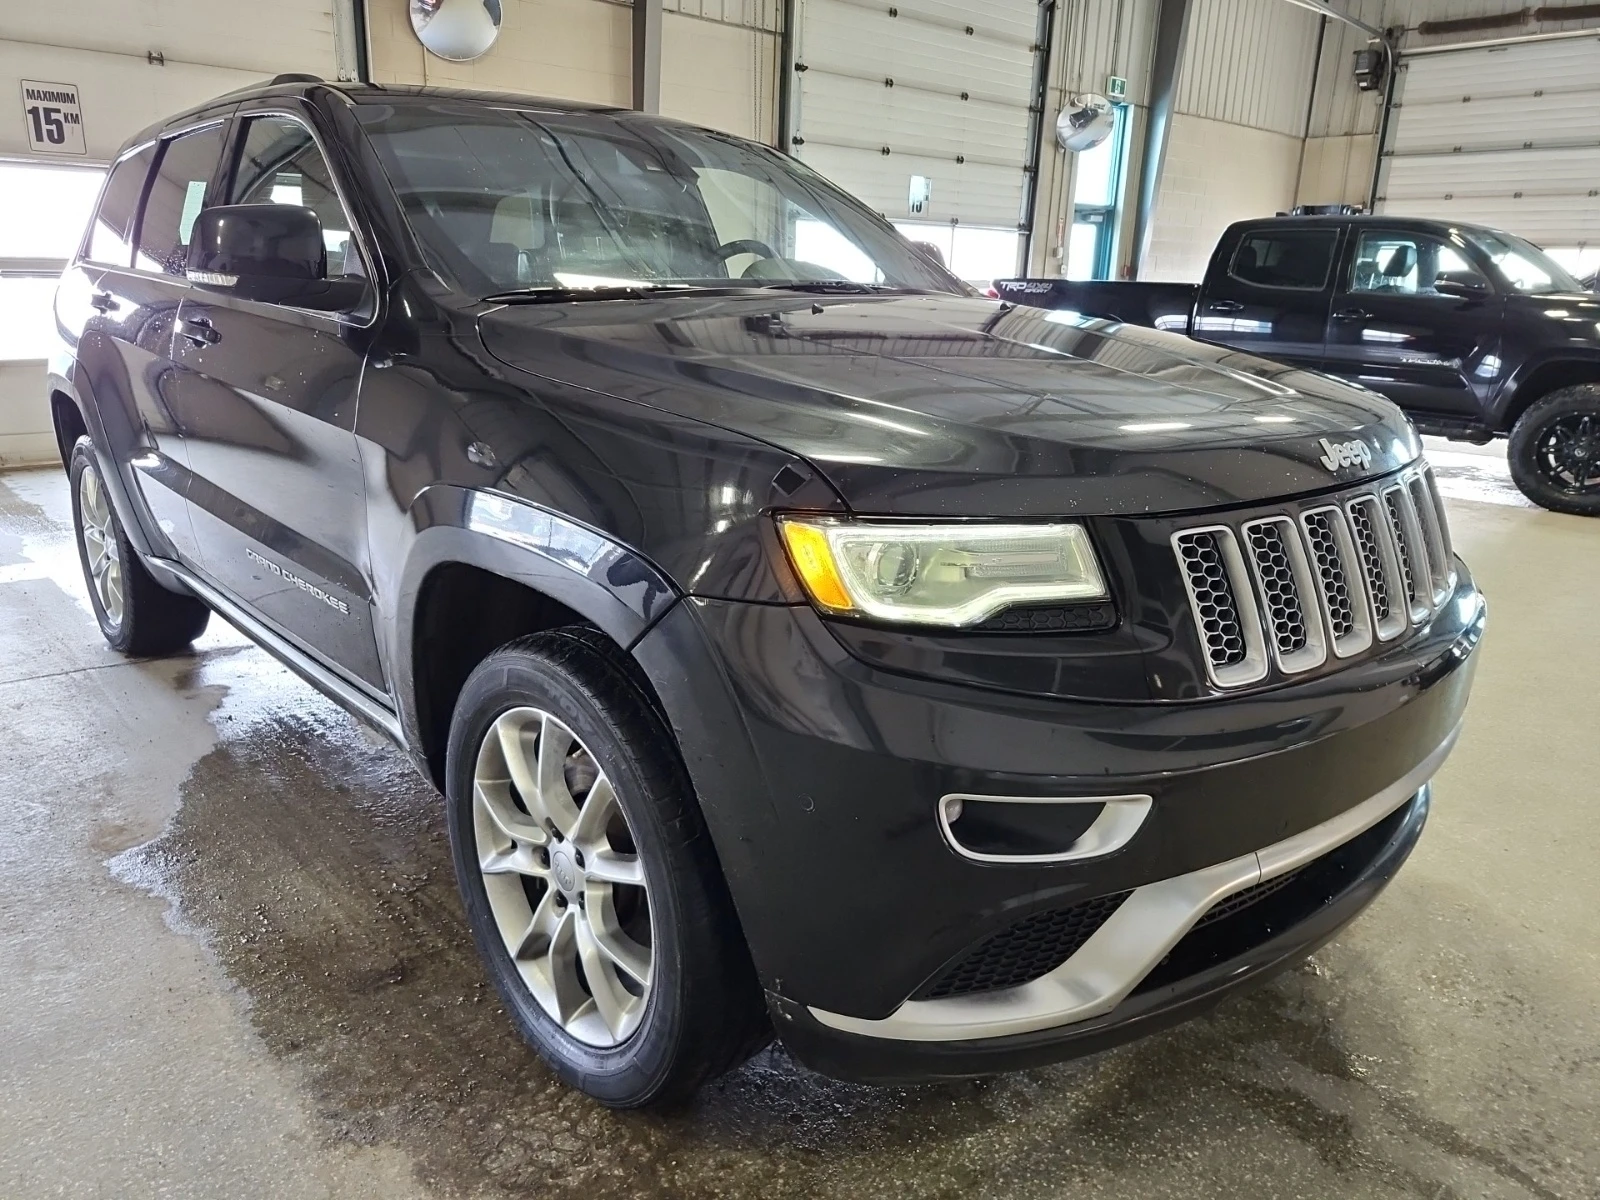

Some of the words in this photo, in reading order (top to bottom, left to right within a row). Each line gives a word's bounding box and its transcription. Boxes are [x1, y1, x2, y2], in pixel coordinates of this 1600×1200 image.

[25, 88, 76, 105] MAXIMUM
[27, 105, 66, 145] 15
[63, 112, 80, 125] KM
[1000, 281, 1027, 291] TRD
[1318, 437, 1372, 472] Jeep
[281, 569, 351, 615] CHEROKEE
